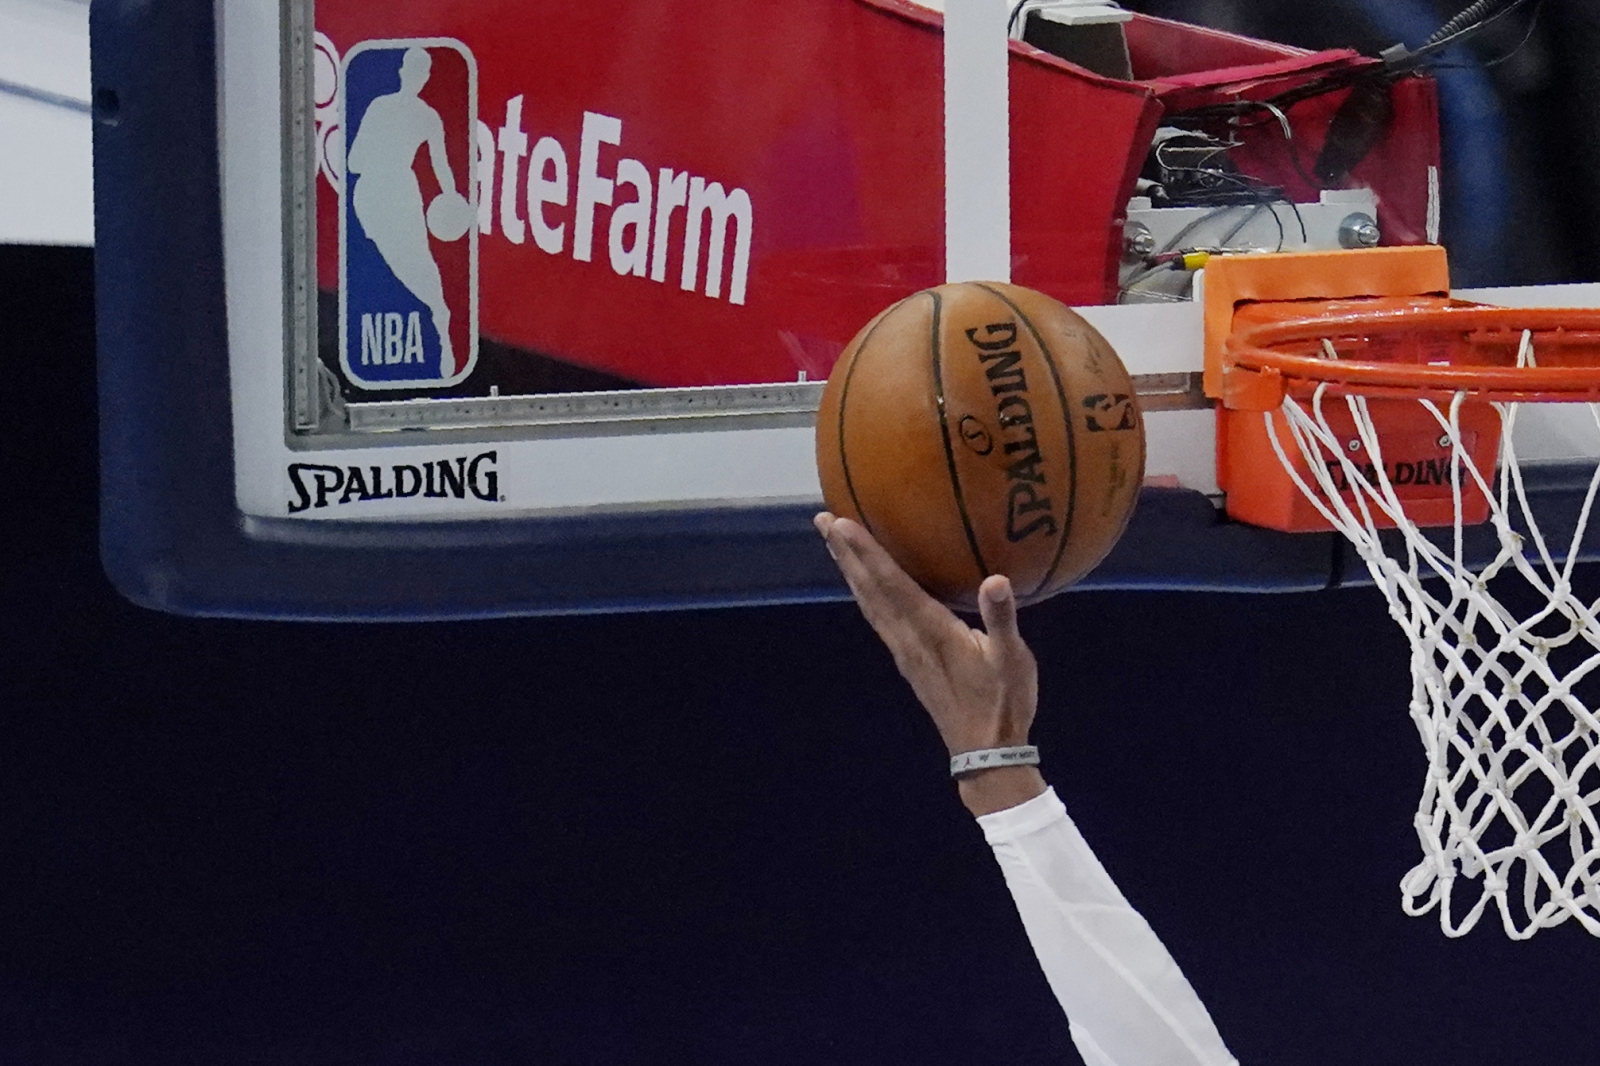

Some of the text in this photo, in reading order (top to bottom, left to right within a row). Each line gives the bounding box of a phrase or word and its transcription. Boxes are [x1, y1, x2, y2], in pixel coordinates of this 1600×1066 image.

[361, 311, 424, 366] NBA
[965, 321, 1058, 543] SPALDING
[288, 451, 499, 514] SPALDING
